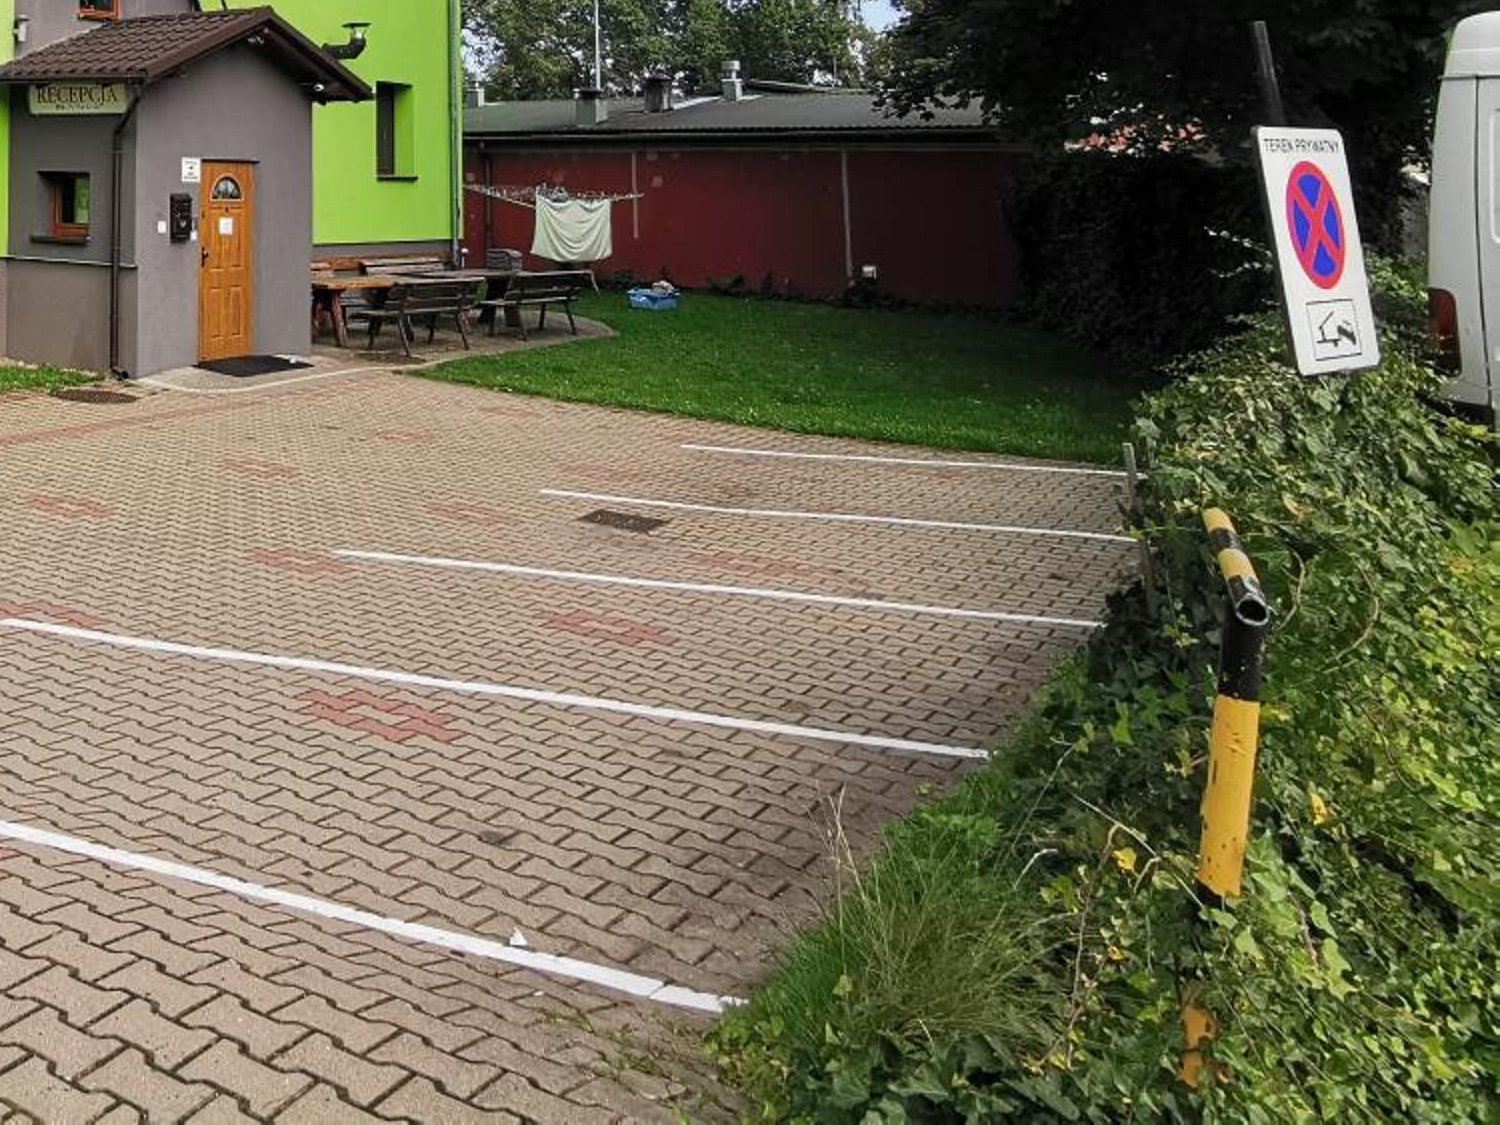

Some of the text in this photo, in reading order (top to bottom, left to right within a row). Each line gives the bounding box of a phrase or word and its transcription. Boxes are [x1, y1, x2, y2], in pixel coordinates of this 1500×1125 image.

[36, 85, 117, 105] RECEPCJA
[1263, 138, 1339, 153] TEREN PRYWATNY
